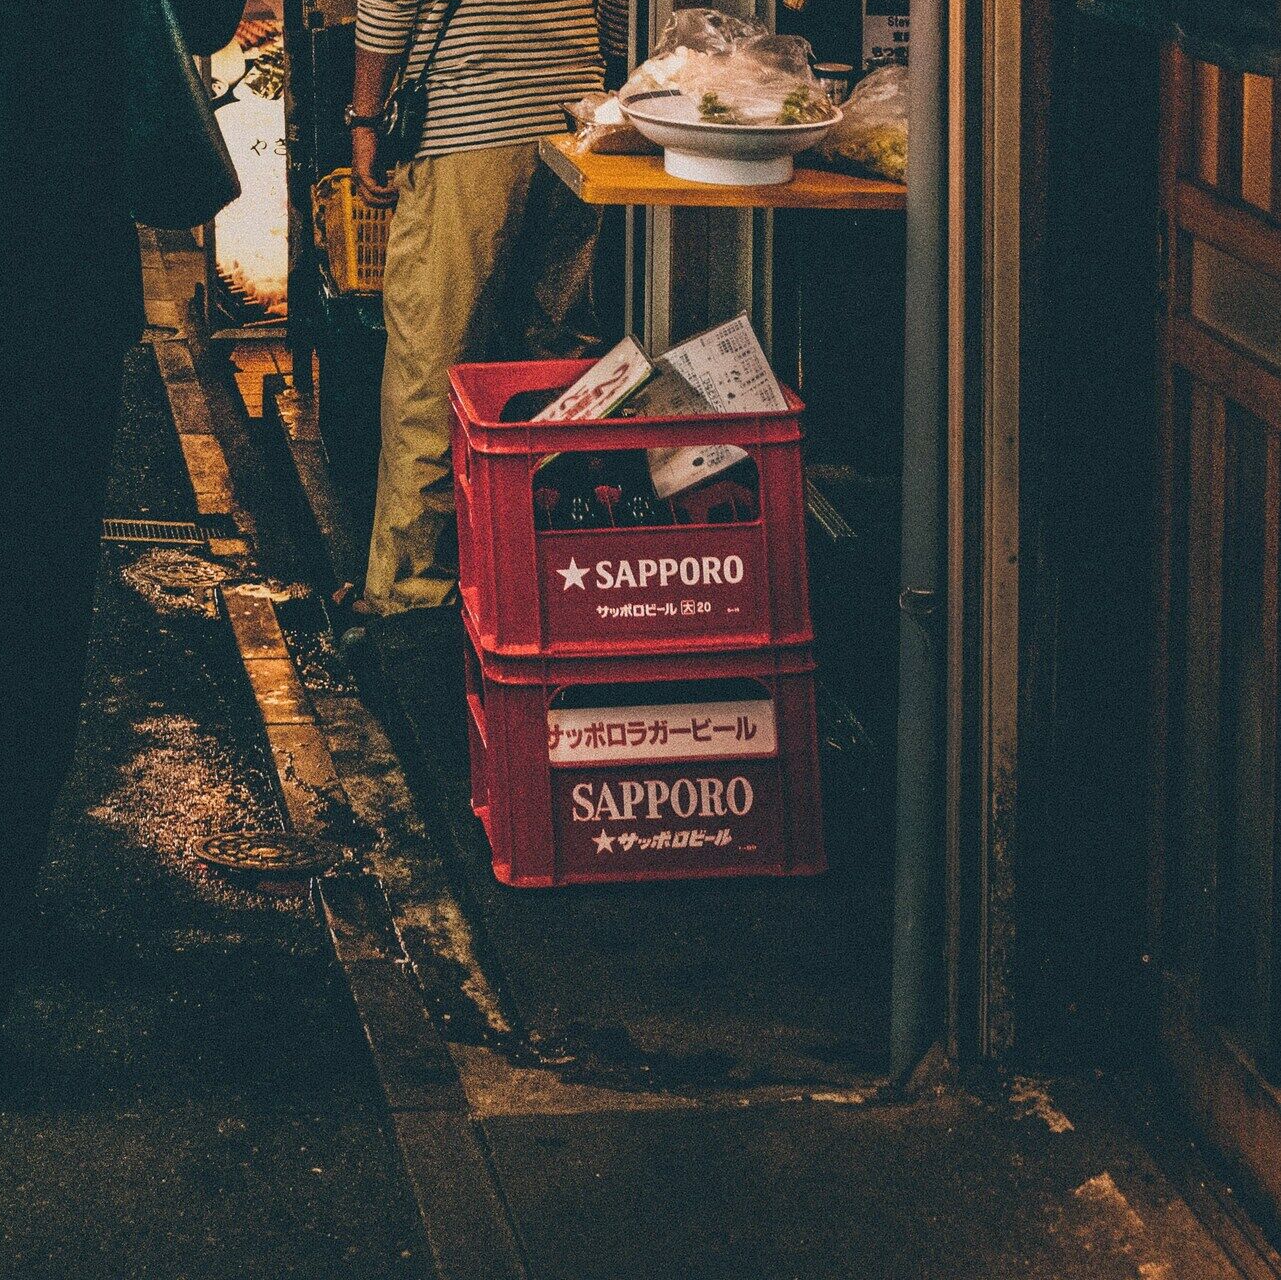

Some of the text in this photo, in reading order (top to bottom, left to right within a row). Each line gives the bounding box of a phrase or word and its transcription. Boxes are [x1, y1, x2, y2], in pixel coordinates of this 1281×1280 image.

[595, 555, 744, 590] SAPPORO
[596, 602, 678, 618] サッポロビール
[549, 715, 758, 750] サッポロラガービール
[572, 775, 754, 822] SAPPORO
[617, 828, 733, 851] サッポロビール
